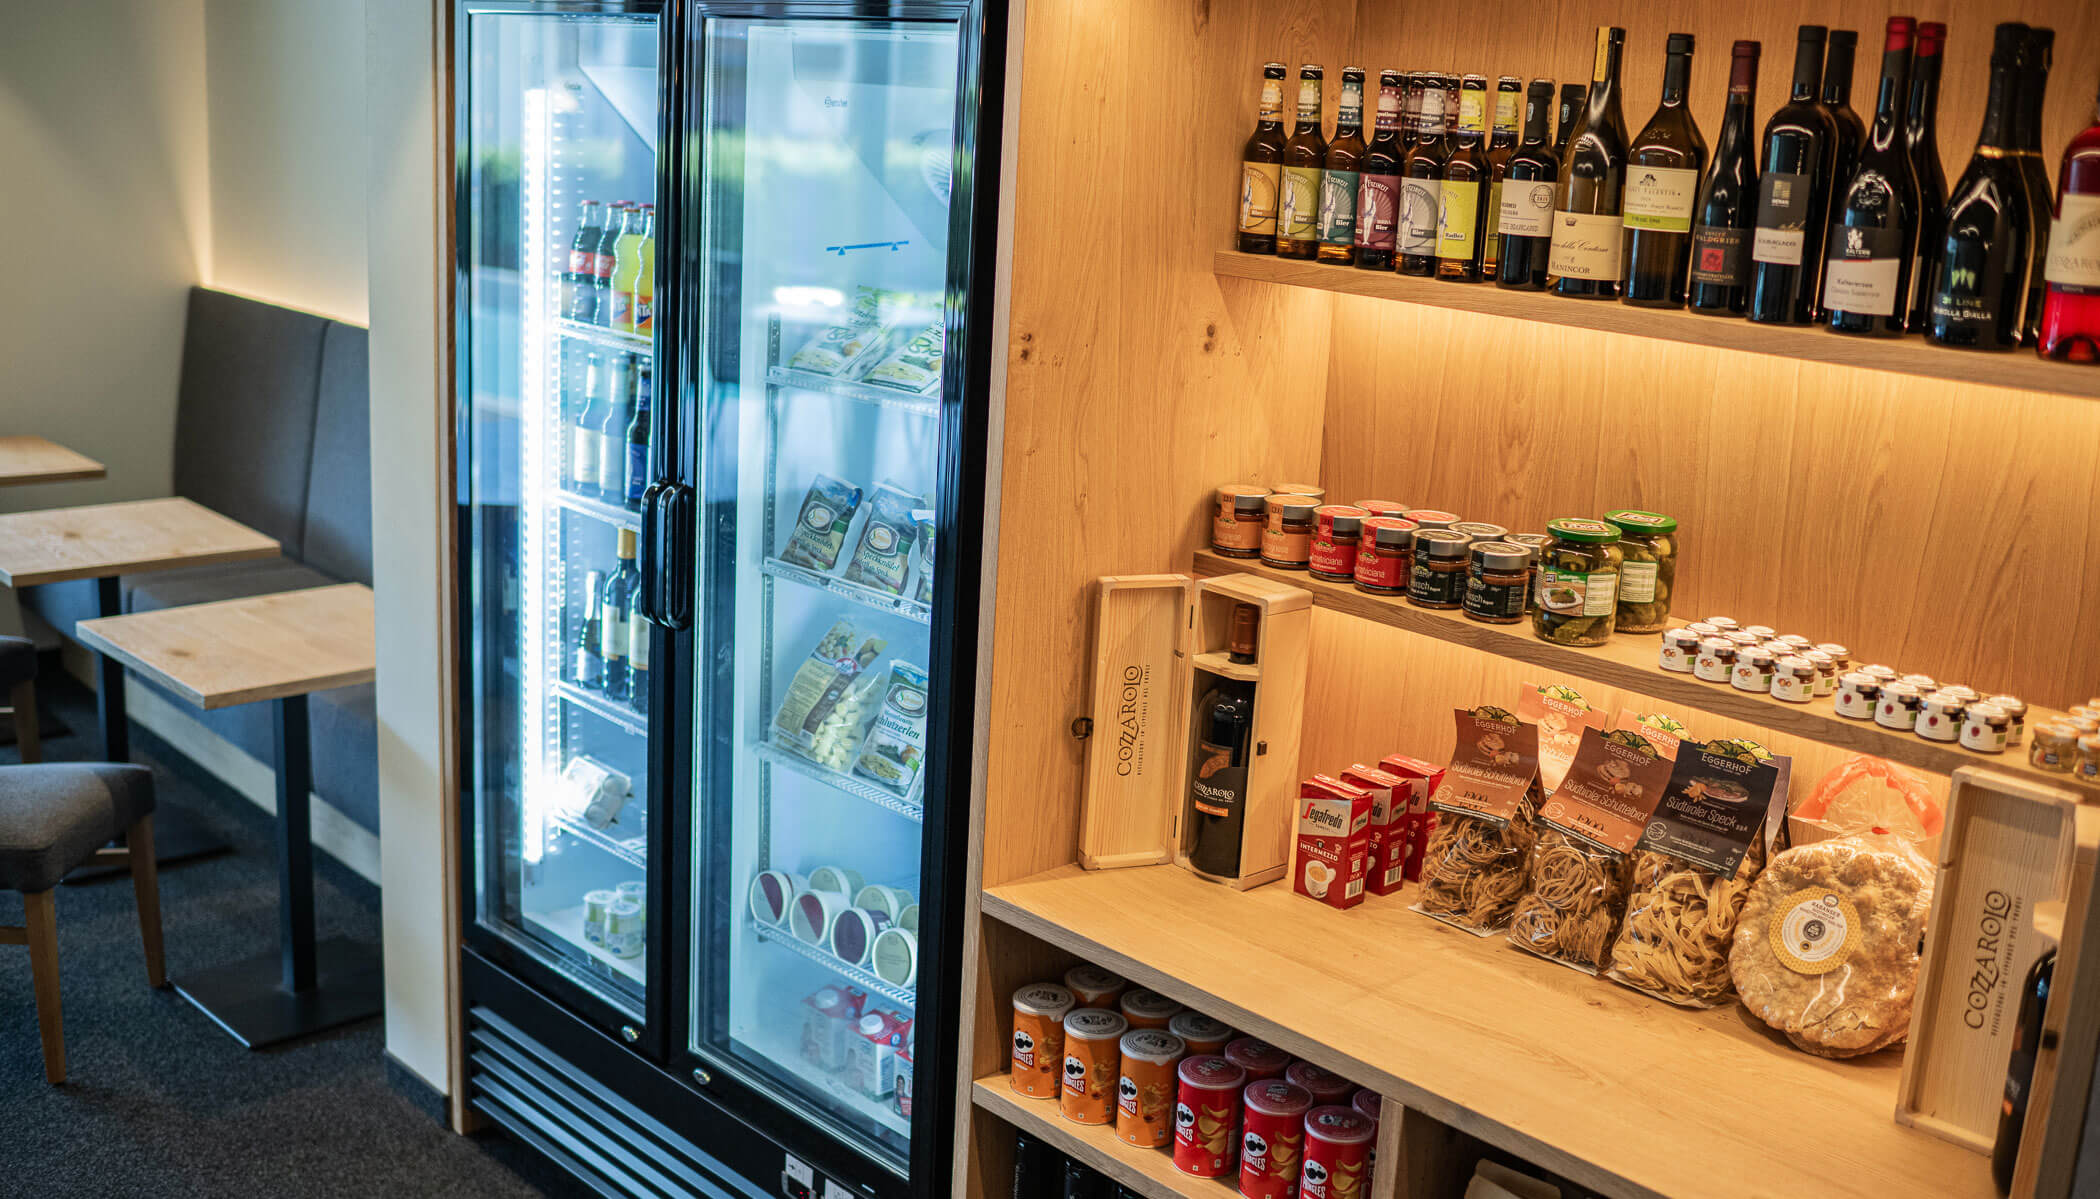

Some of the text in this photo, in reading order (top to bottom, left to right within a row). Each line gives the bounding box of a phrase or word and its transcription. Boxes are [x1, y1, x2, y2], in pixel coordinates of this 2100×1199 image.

[1368, 179, 1389, 192] FREIHEIT
[1542, 696, 1585, 717] EGGERHOF
[1117, 665, 1143, 776] COZZAROLO
[1475, 719, 1517, 734] EGGERHOF
[1640, 725, 1680, 747] EGGERHO
[1603, 742, 1652, 766] EGGERHOF
[1701, 752, 1753, 775] EGGERHOF
[1194, 780, 1235, 800] COZZAROLO
[1302, 802, 1343, 829] Segafredo
[1666, 796, 1738, 829] Südtiroler Speck
[1300, 842, 1339, 862] INTERMEZZO
[1964, 890, 2012, 1030] COZZAROLO
[1243, 1151, 1266, 1171] PRINGLES
[1303, 1175, 1326, 1199] PRINGLES
